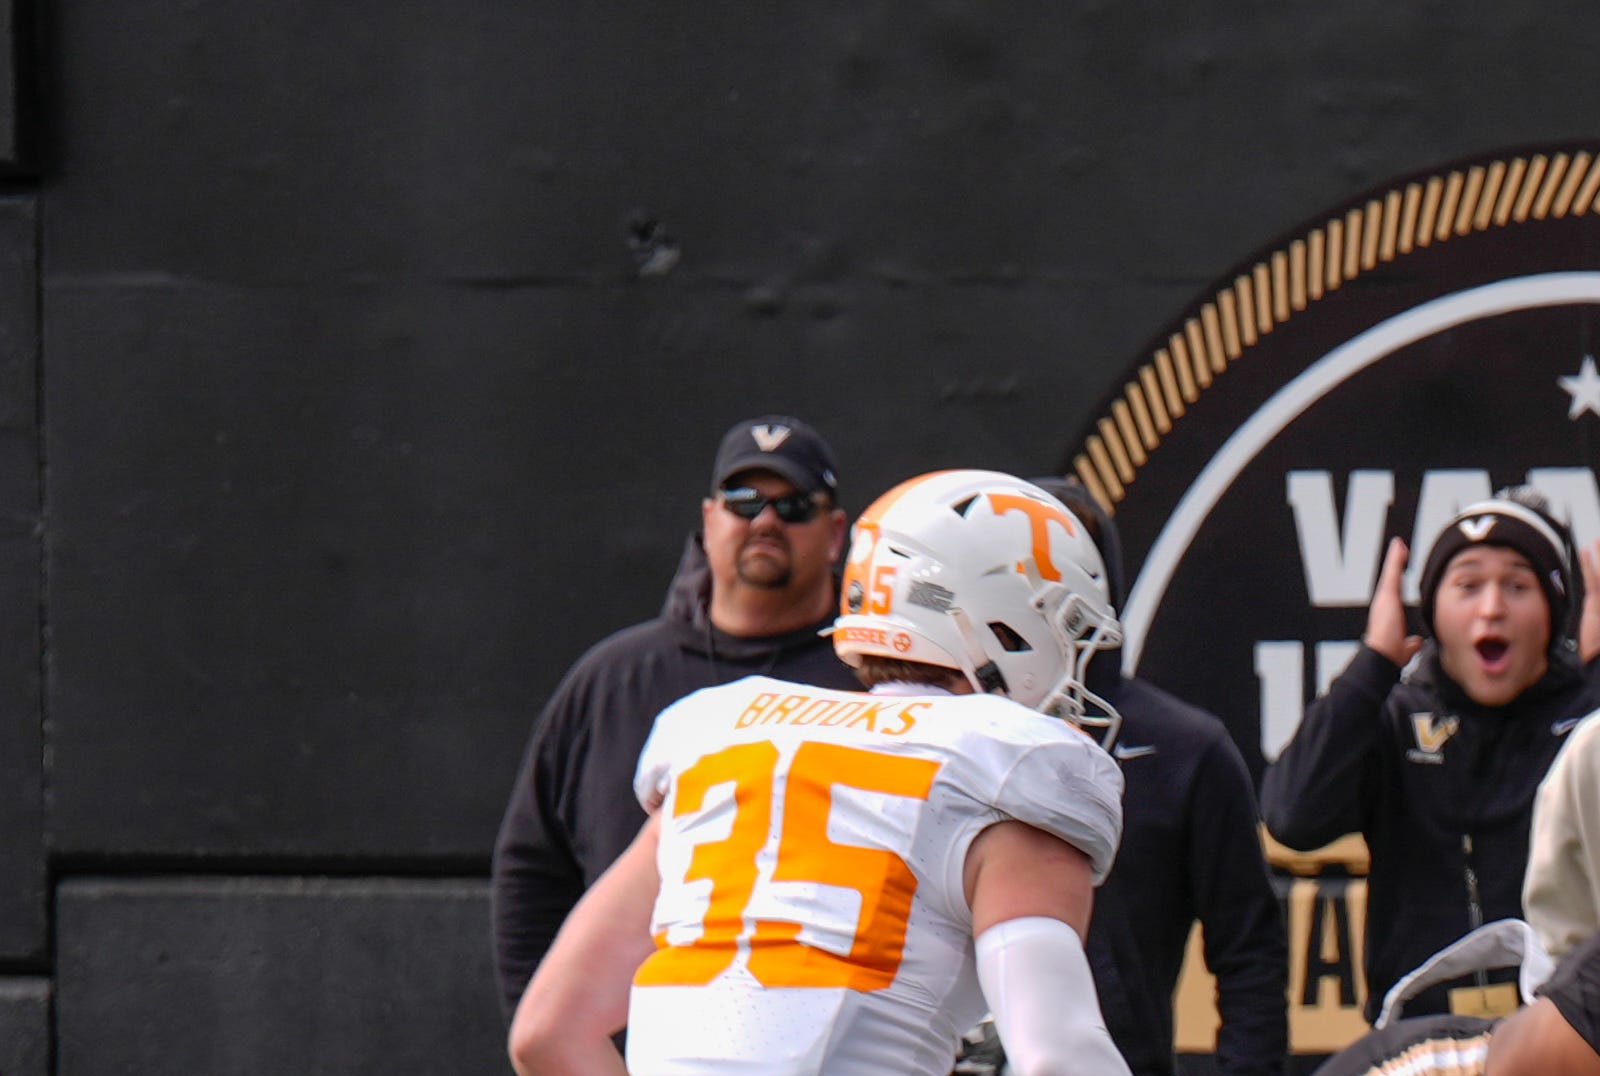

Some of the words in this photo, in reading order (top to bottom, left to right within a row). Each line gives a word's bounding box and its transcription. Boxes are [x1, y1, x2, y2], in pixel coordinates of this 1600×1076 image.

[987, 493, 1076, 583] T
[1459, 514, 1497, 541] V
[734, 692, 933, 736] BROOKS
[631, 739, 943, 993] 35
